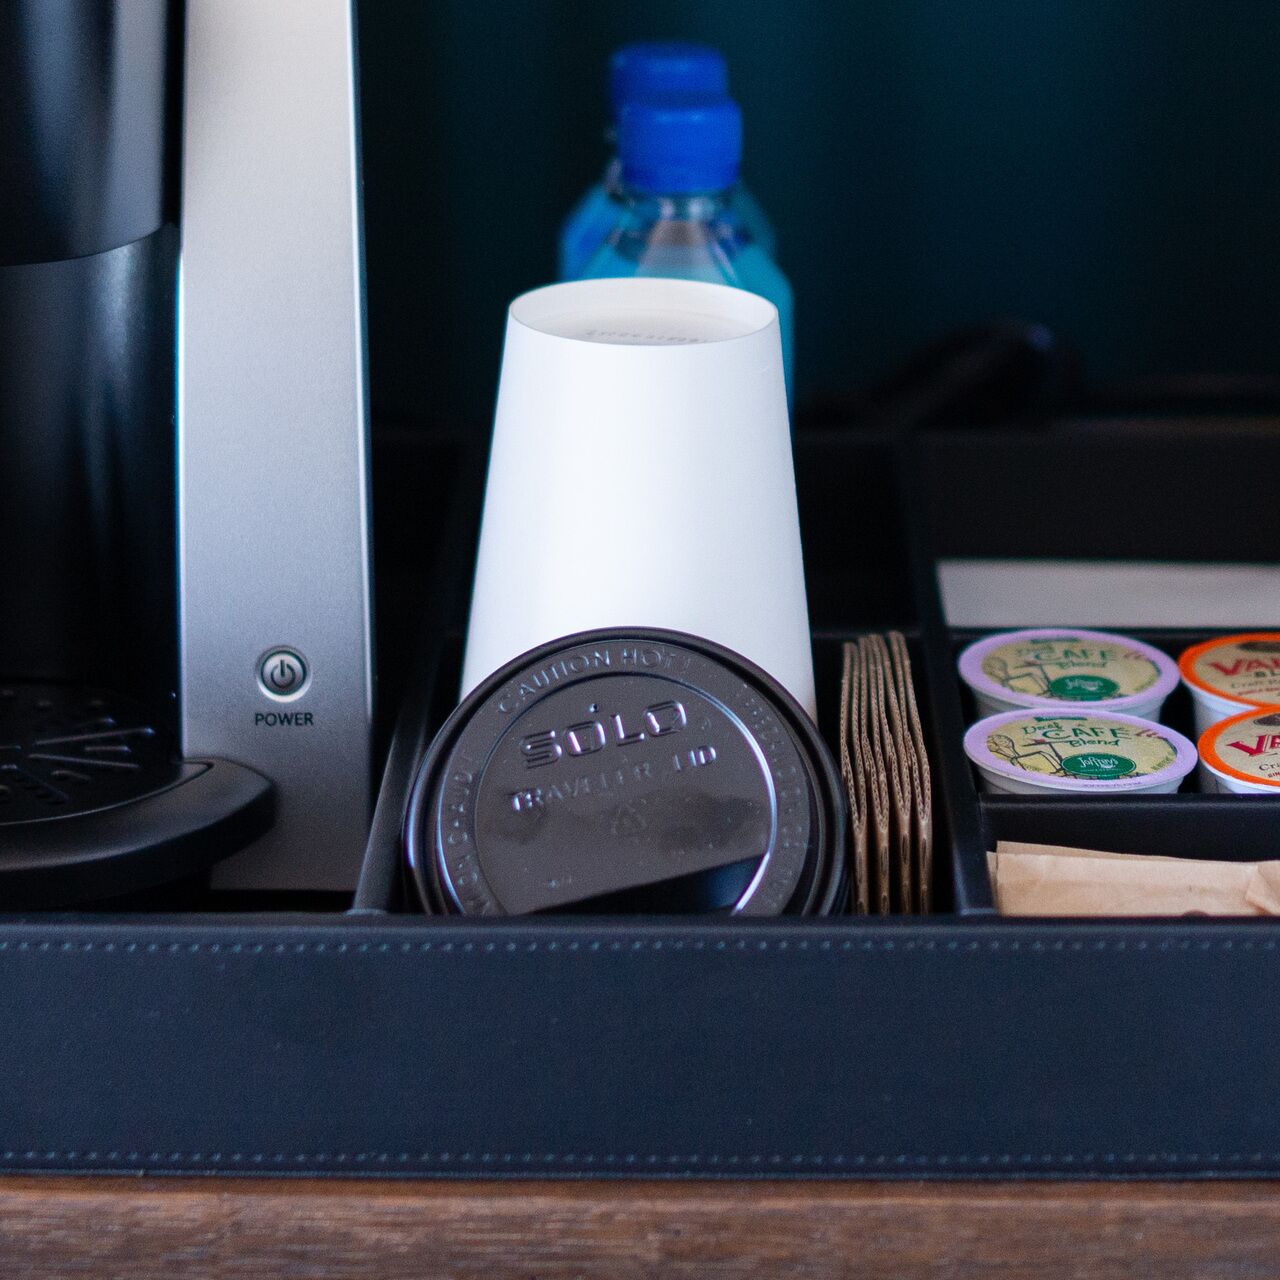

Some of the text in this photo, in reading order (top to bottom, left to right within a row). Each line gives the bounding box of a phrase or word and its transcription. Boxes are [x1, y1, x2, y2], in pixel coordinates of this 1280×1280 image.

[497, 650, 611, 713] CAUTION
[254, 712, 314, 727] POWER
[520, 699, 688, 770] SOLO
[1070, 737, 1121, 748] Blend
